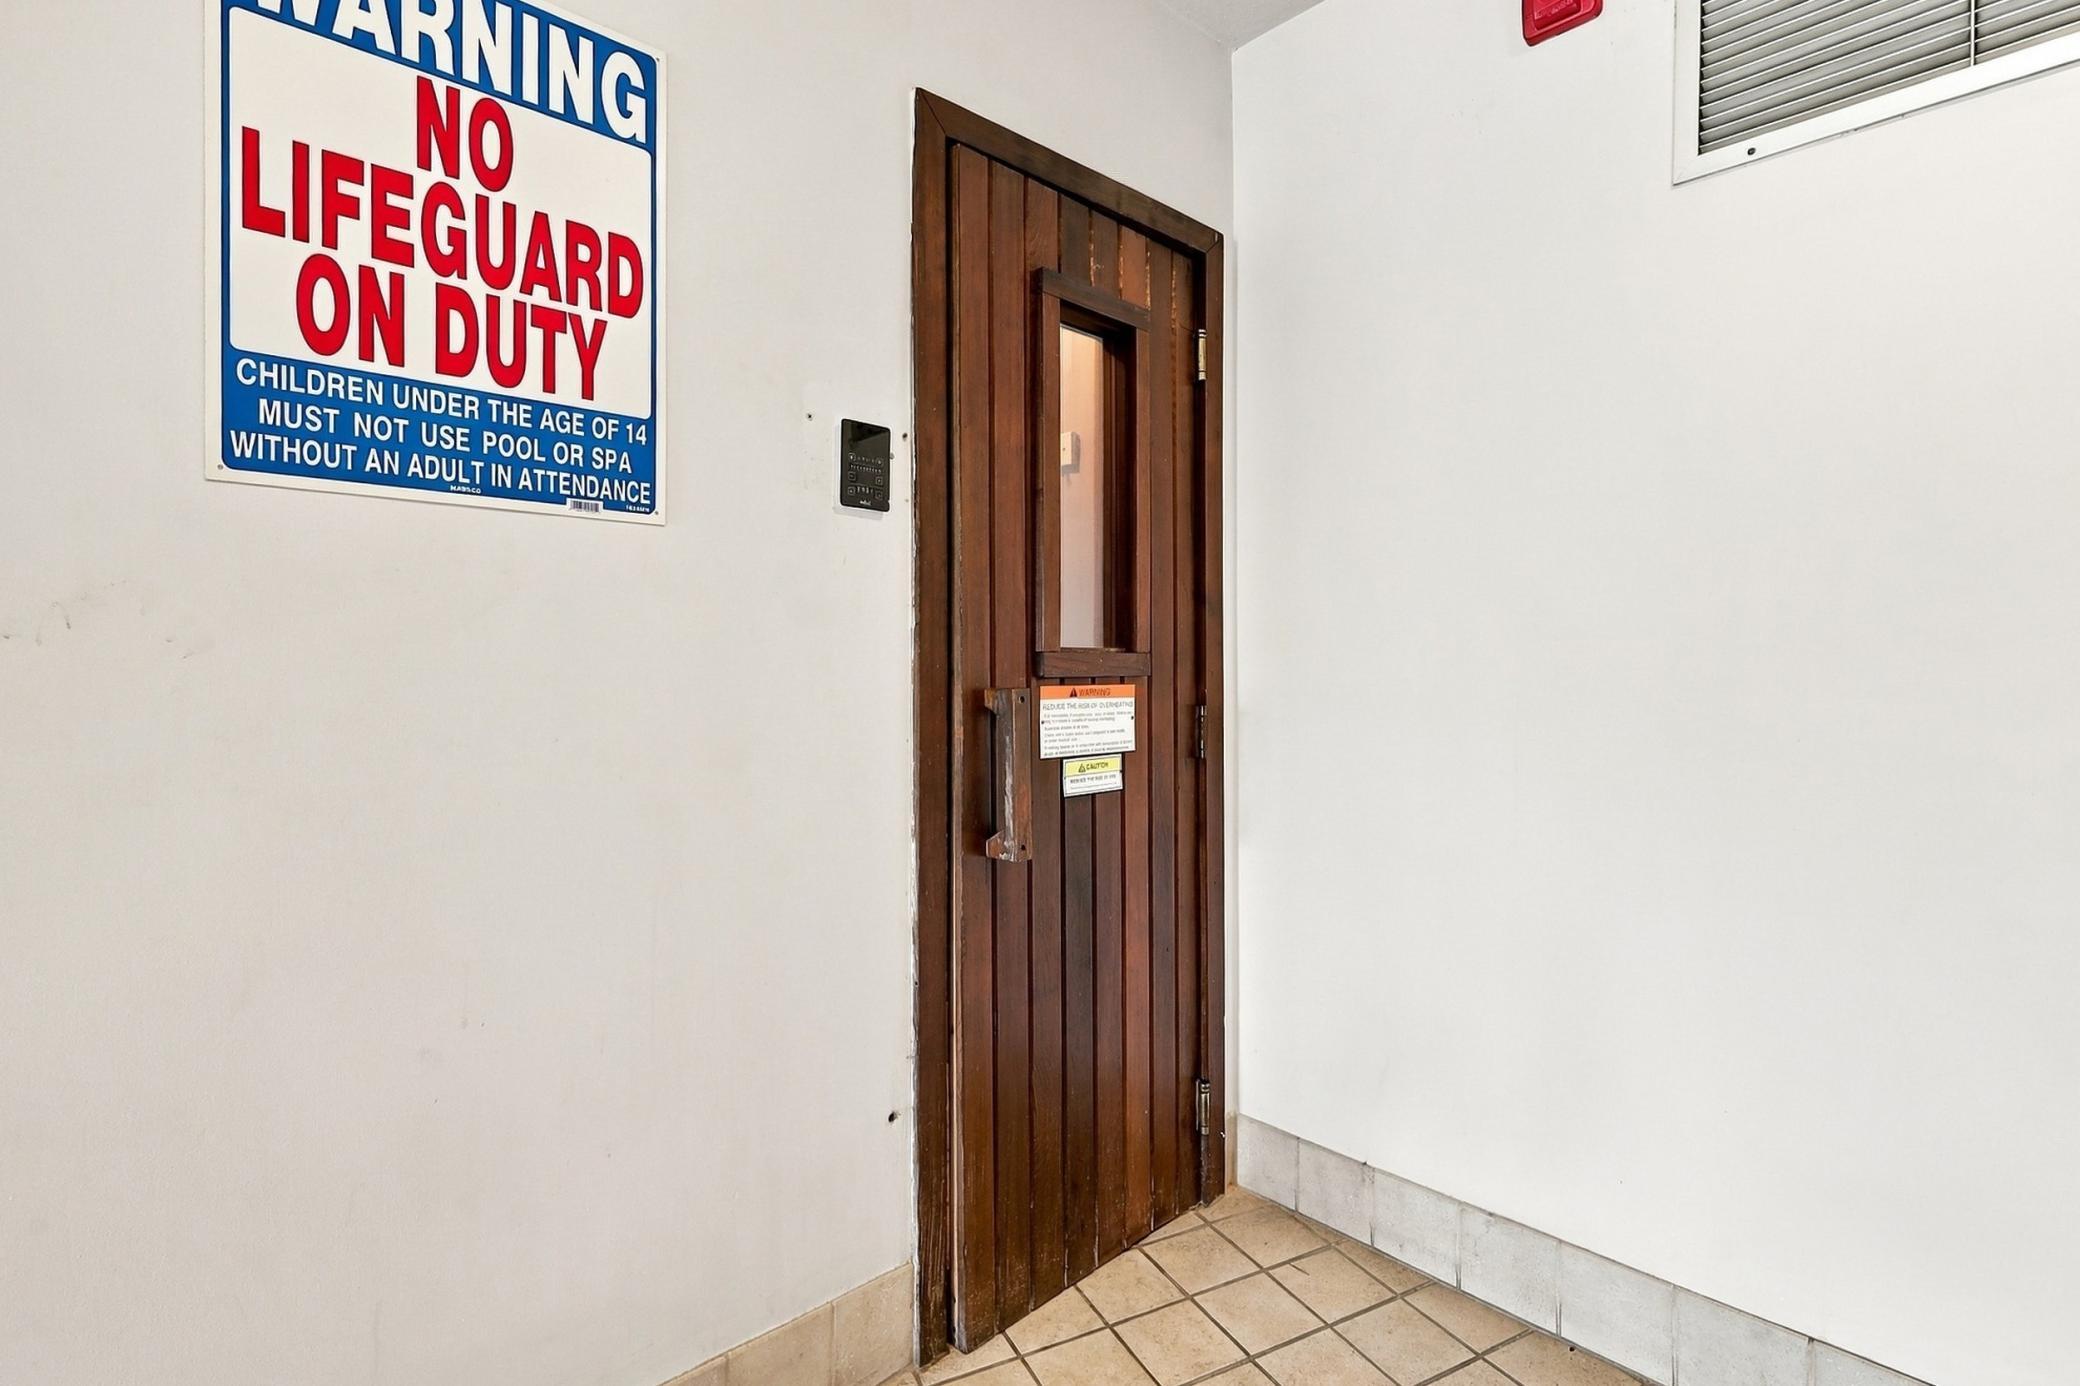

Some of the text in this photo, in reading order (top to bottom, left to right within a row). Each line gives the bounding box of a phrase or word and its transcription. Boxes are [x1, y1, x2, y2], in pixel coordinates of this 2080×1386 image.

[257, 0, 647, 144] ARNING
[416, 75, 514, 193] NO
[241, 125, 644, 320] LIFEGUARD
[295, 253, 608, 402] ON DUTY
[236, 357, 647, 446] CHILDREN UNDER THE AGE OF 14
[258, 398, 632, 474] MUST NOT USE POOL OR SPA
[230, 429, 651, 504] WITHOUT AN ADULT IN ATTENDANCE
